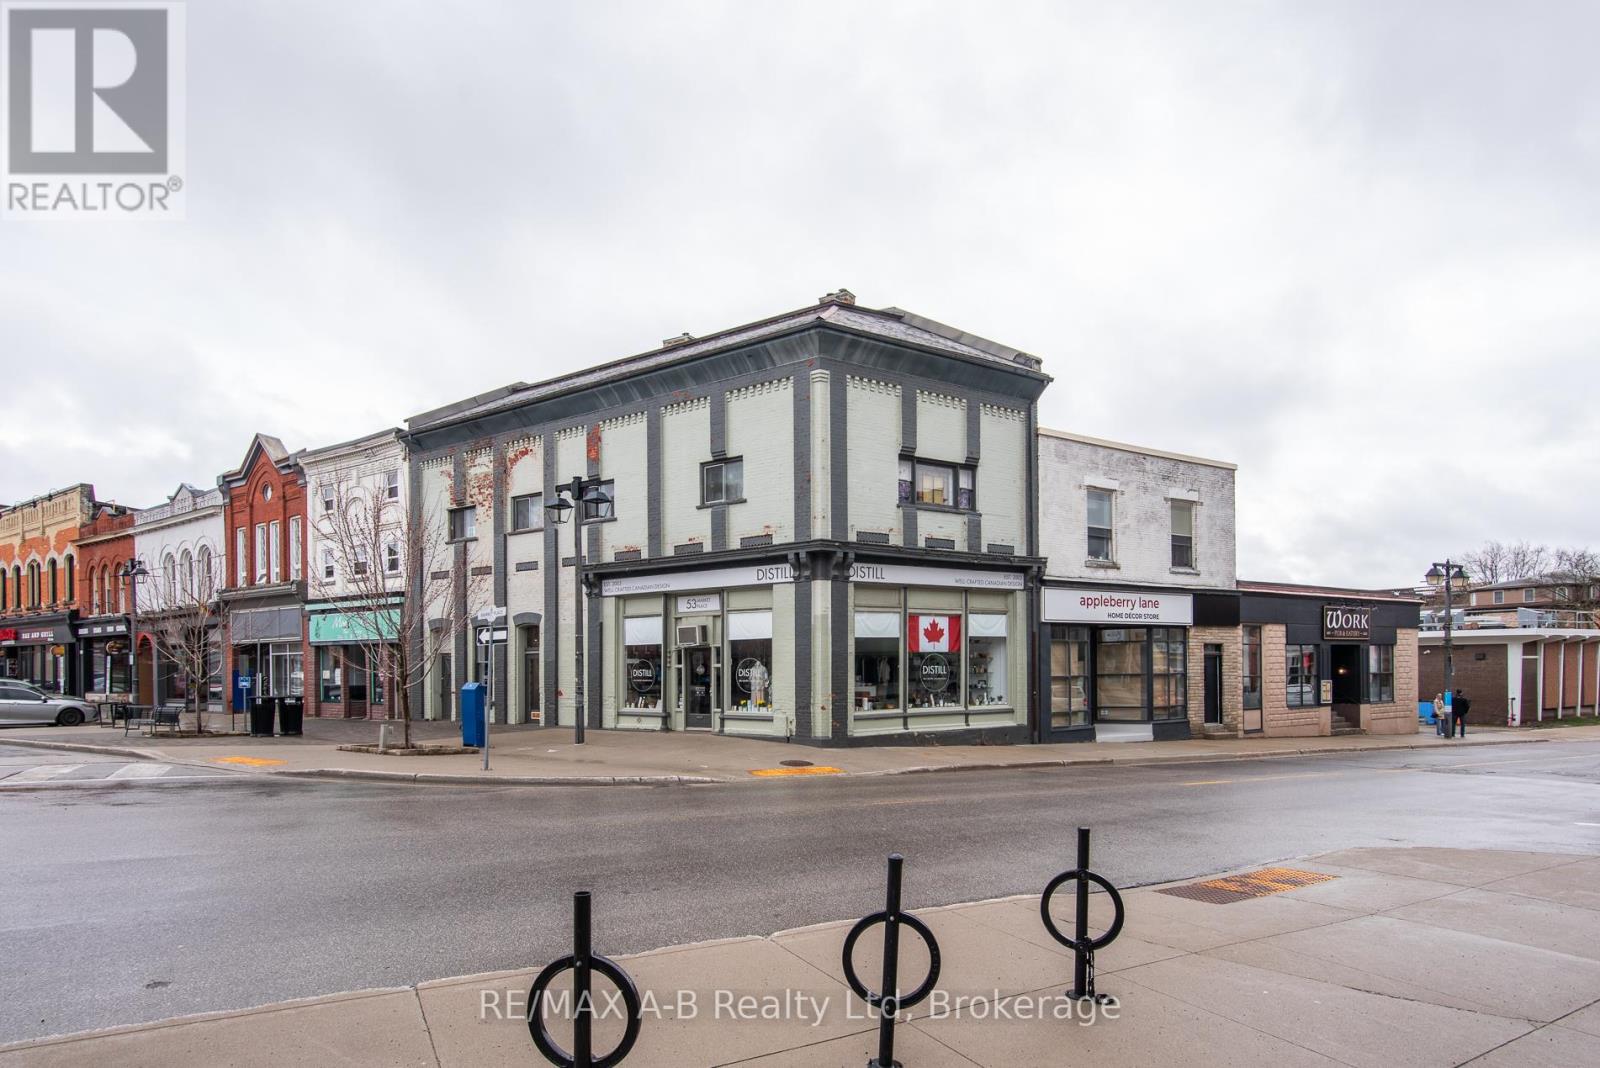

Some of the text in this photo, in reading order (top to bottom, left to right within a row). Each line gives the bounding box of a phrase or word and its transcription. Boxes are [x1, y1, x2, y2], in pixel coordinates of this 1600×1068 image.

[756, 567, 794, 581] DISTILL
[849, 565, 886, 580] DISTILL
[686, 598, 697, 609] 53
[1080, 595, 1160, 610] appleberry lane
[1125, 611, 1142, 620] DÉCOR
[1327, 610, 1369, 629] WORK
[633, 669, 652, 677] DISTILL
[922, 665, 947, 675] DISTILL
